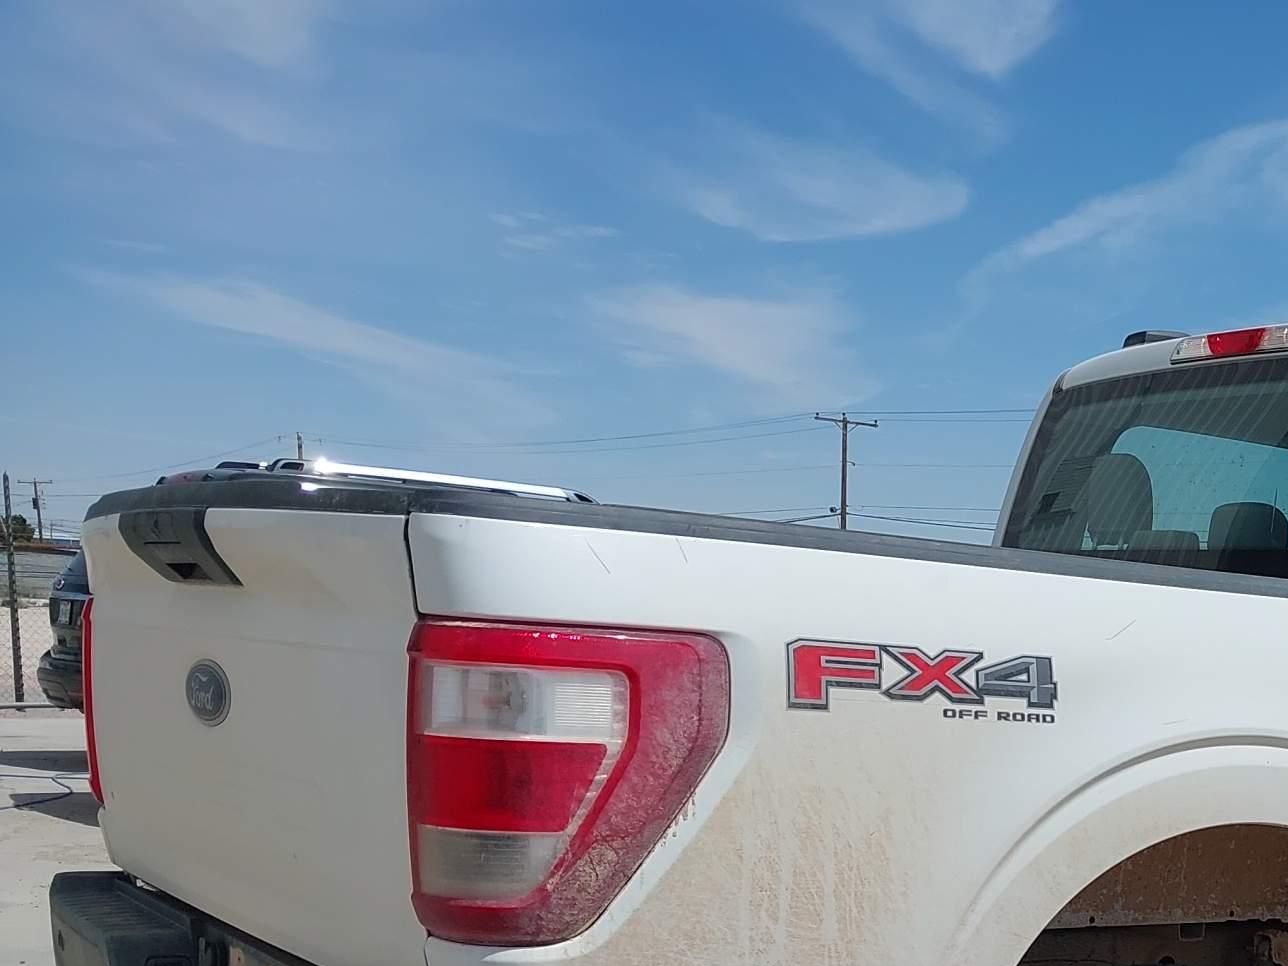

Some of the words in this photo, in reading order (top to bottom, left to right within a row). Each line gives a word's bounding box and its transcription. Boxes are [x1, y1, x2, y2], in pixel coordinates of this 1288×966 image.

[786, 638, 1058, 712] FX4
[943, 707, 988, 721] OFF
[997, 711, 1056, 724] ROAD
